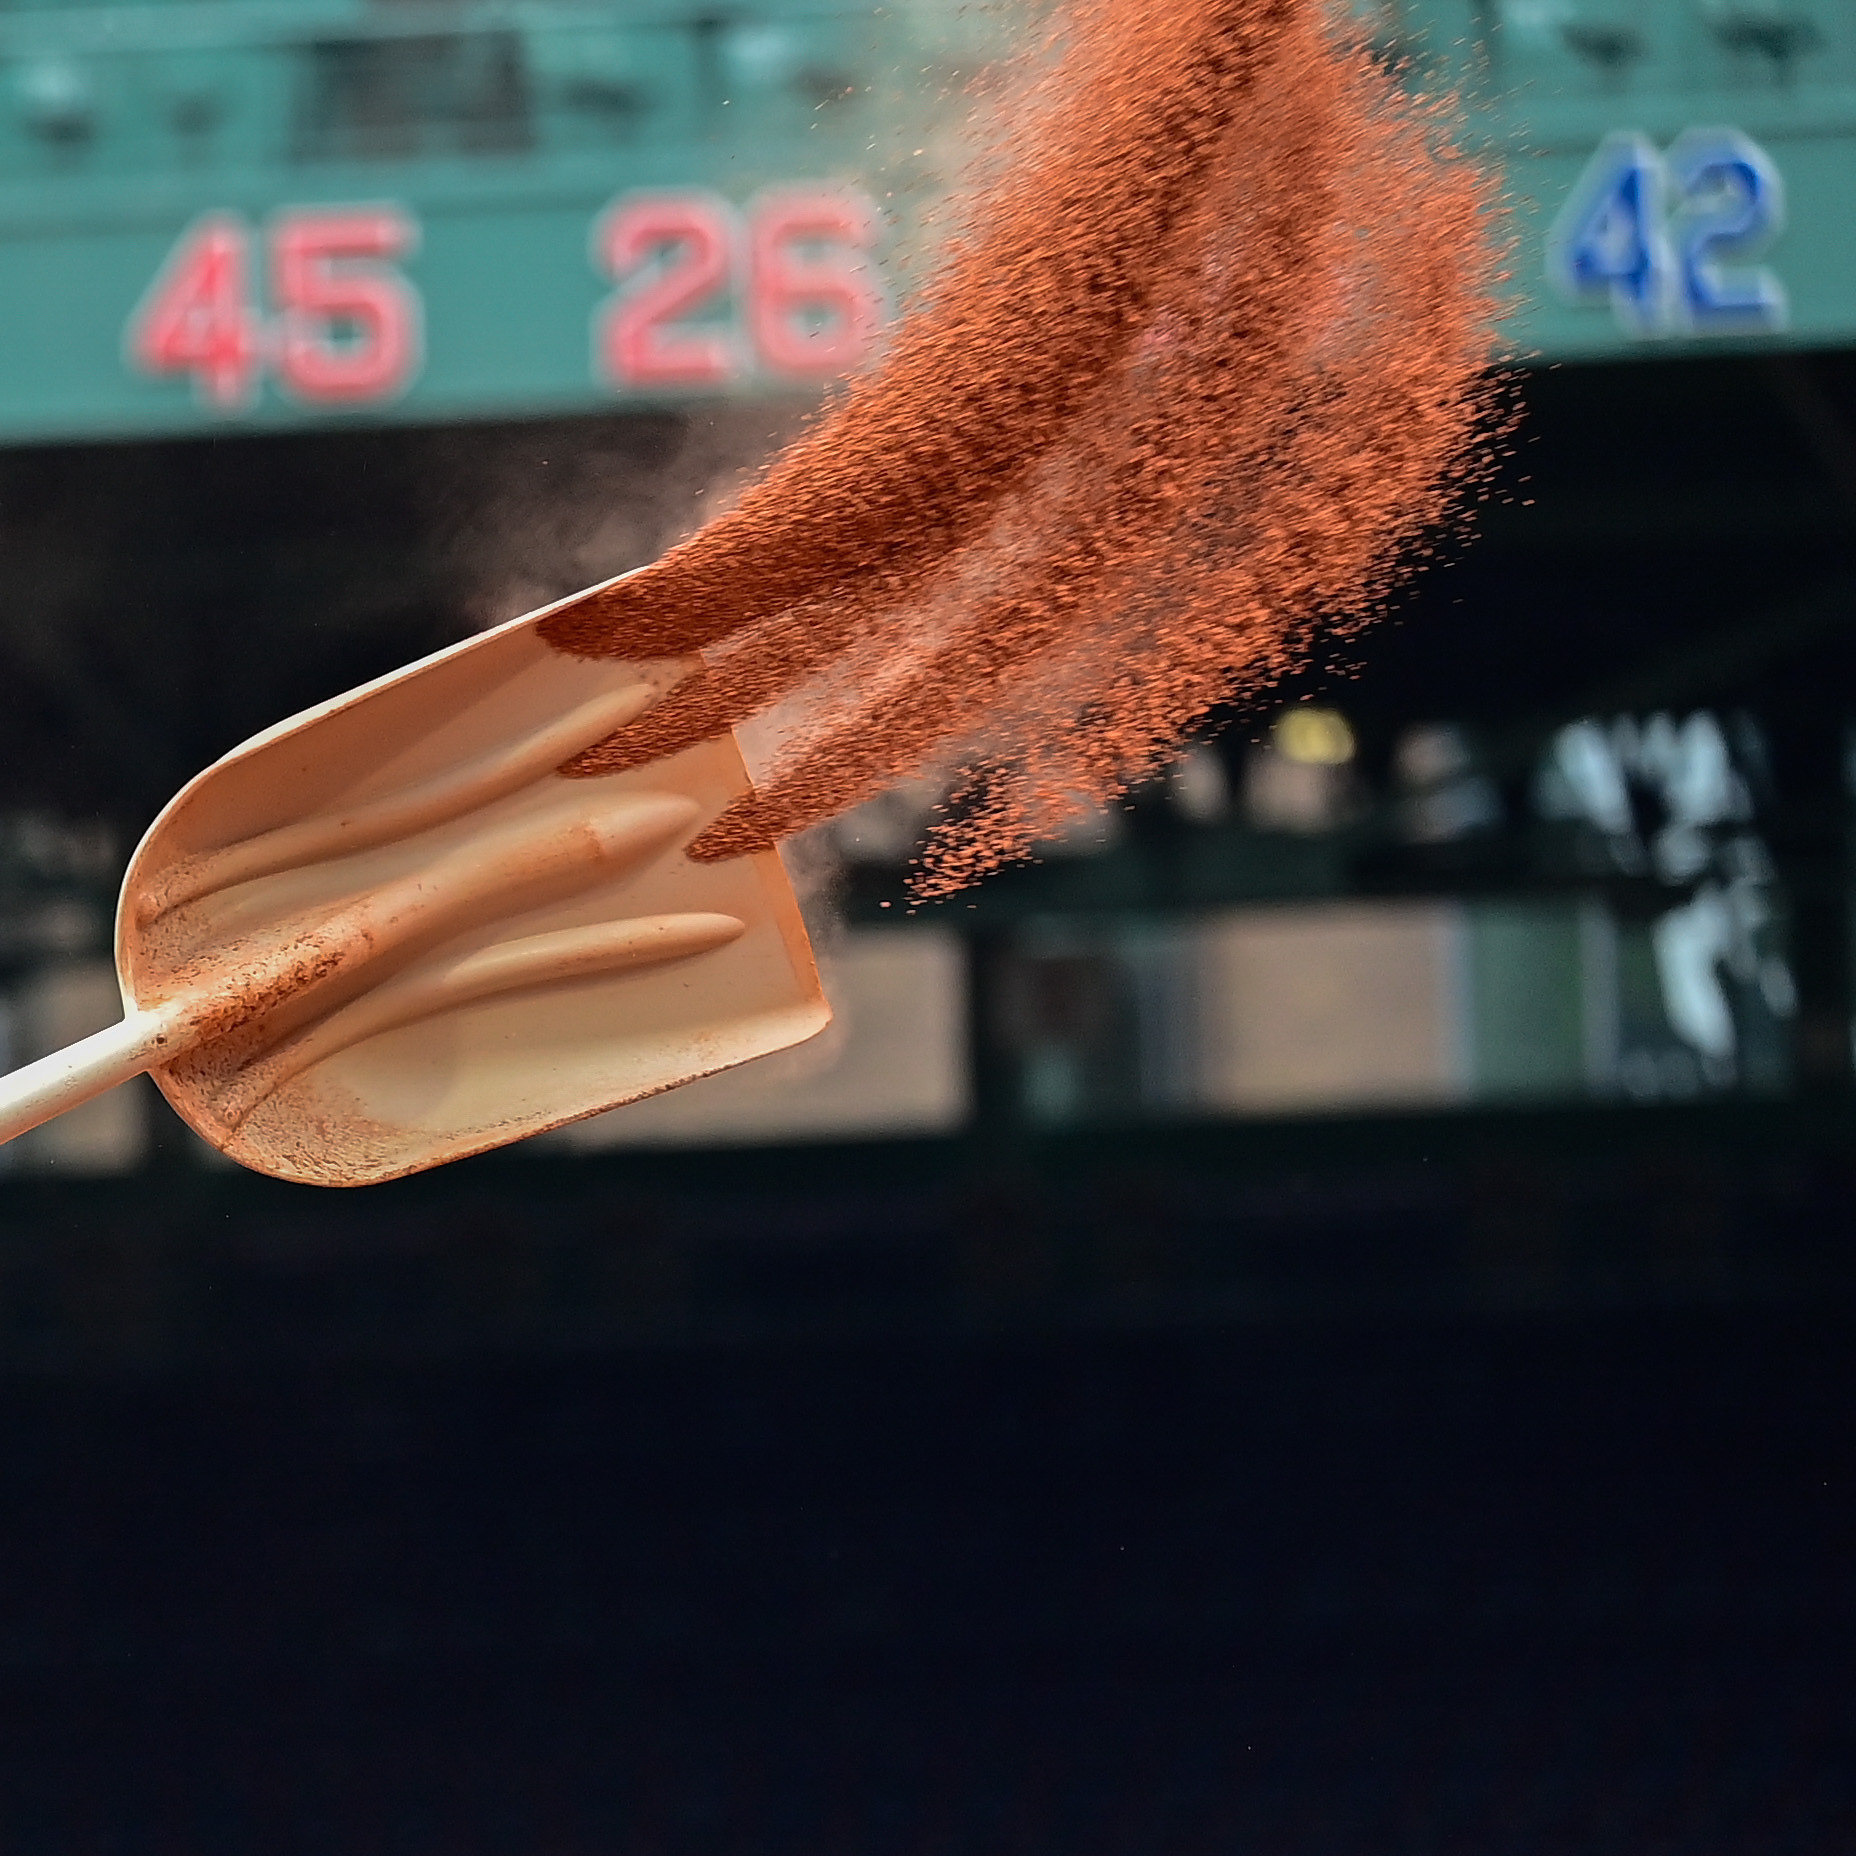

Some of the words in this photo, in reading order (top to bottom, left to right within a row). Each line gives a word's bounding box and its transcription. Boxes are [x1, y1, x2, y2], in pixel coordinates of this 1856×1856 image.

[128, 205, 420, 410] 45
[594, 182, 882, 391] 26
[1548, 129, 1787, 336] 42
